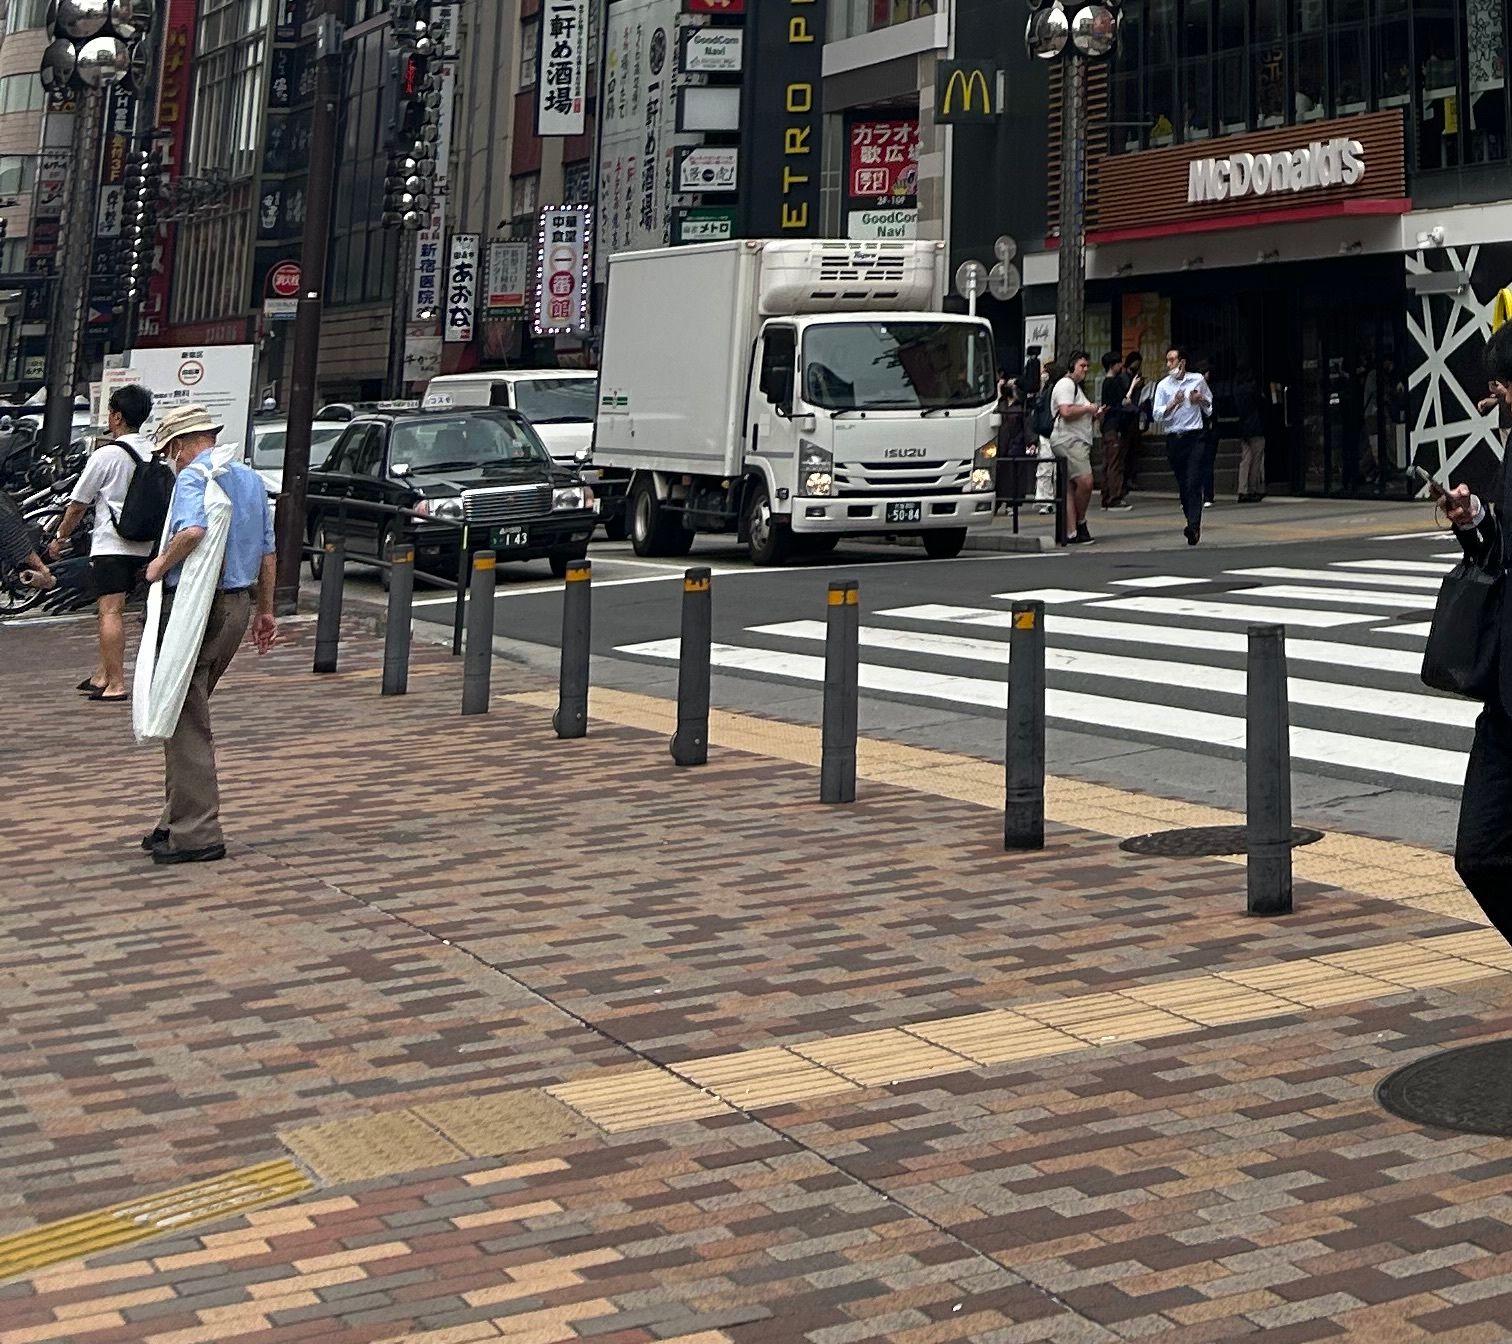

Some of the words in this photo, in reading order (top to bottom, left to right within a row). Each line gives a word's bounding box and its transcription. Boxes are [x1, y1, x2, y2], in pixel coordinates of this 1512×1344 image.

[544, 3, 577, 115] 一軒め酒場
[1187, 137, 1366, 202] McDonald's
[876, 224, 906, 238] Navi
[884, 448, 927, 458] ISUZU
